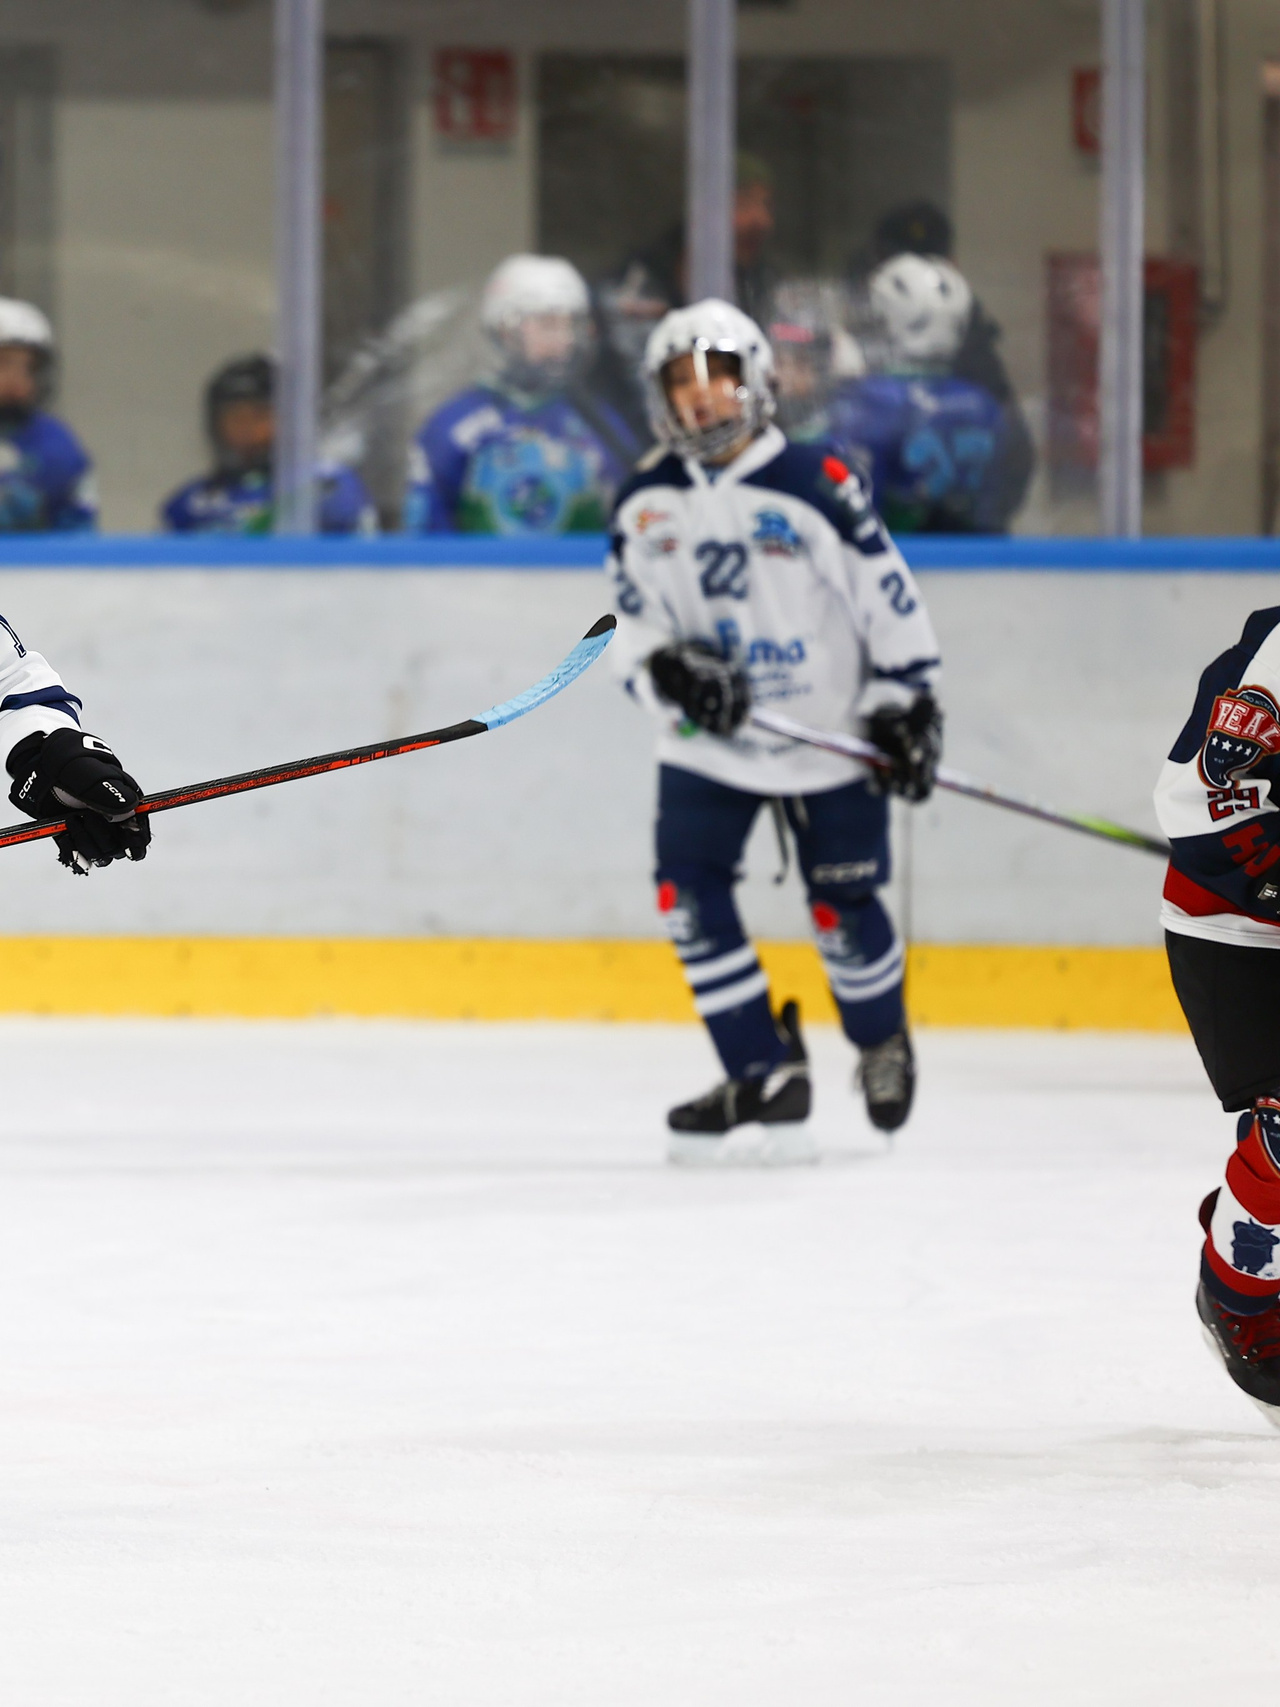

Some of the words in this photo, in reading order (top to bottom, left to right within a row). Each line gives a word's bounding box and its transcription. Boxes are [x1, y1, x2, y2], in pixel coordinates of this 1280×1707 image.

[694, 541, 748, 600] 22
[19, 770, 37, 800] CCM
[102, 781, 126, 803] CCM
